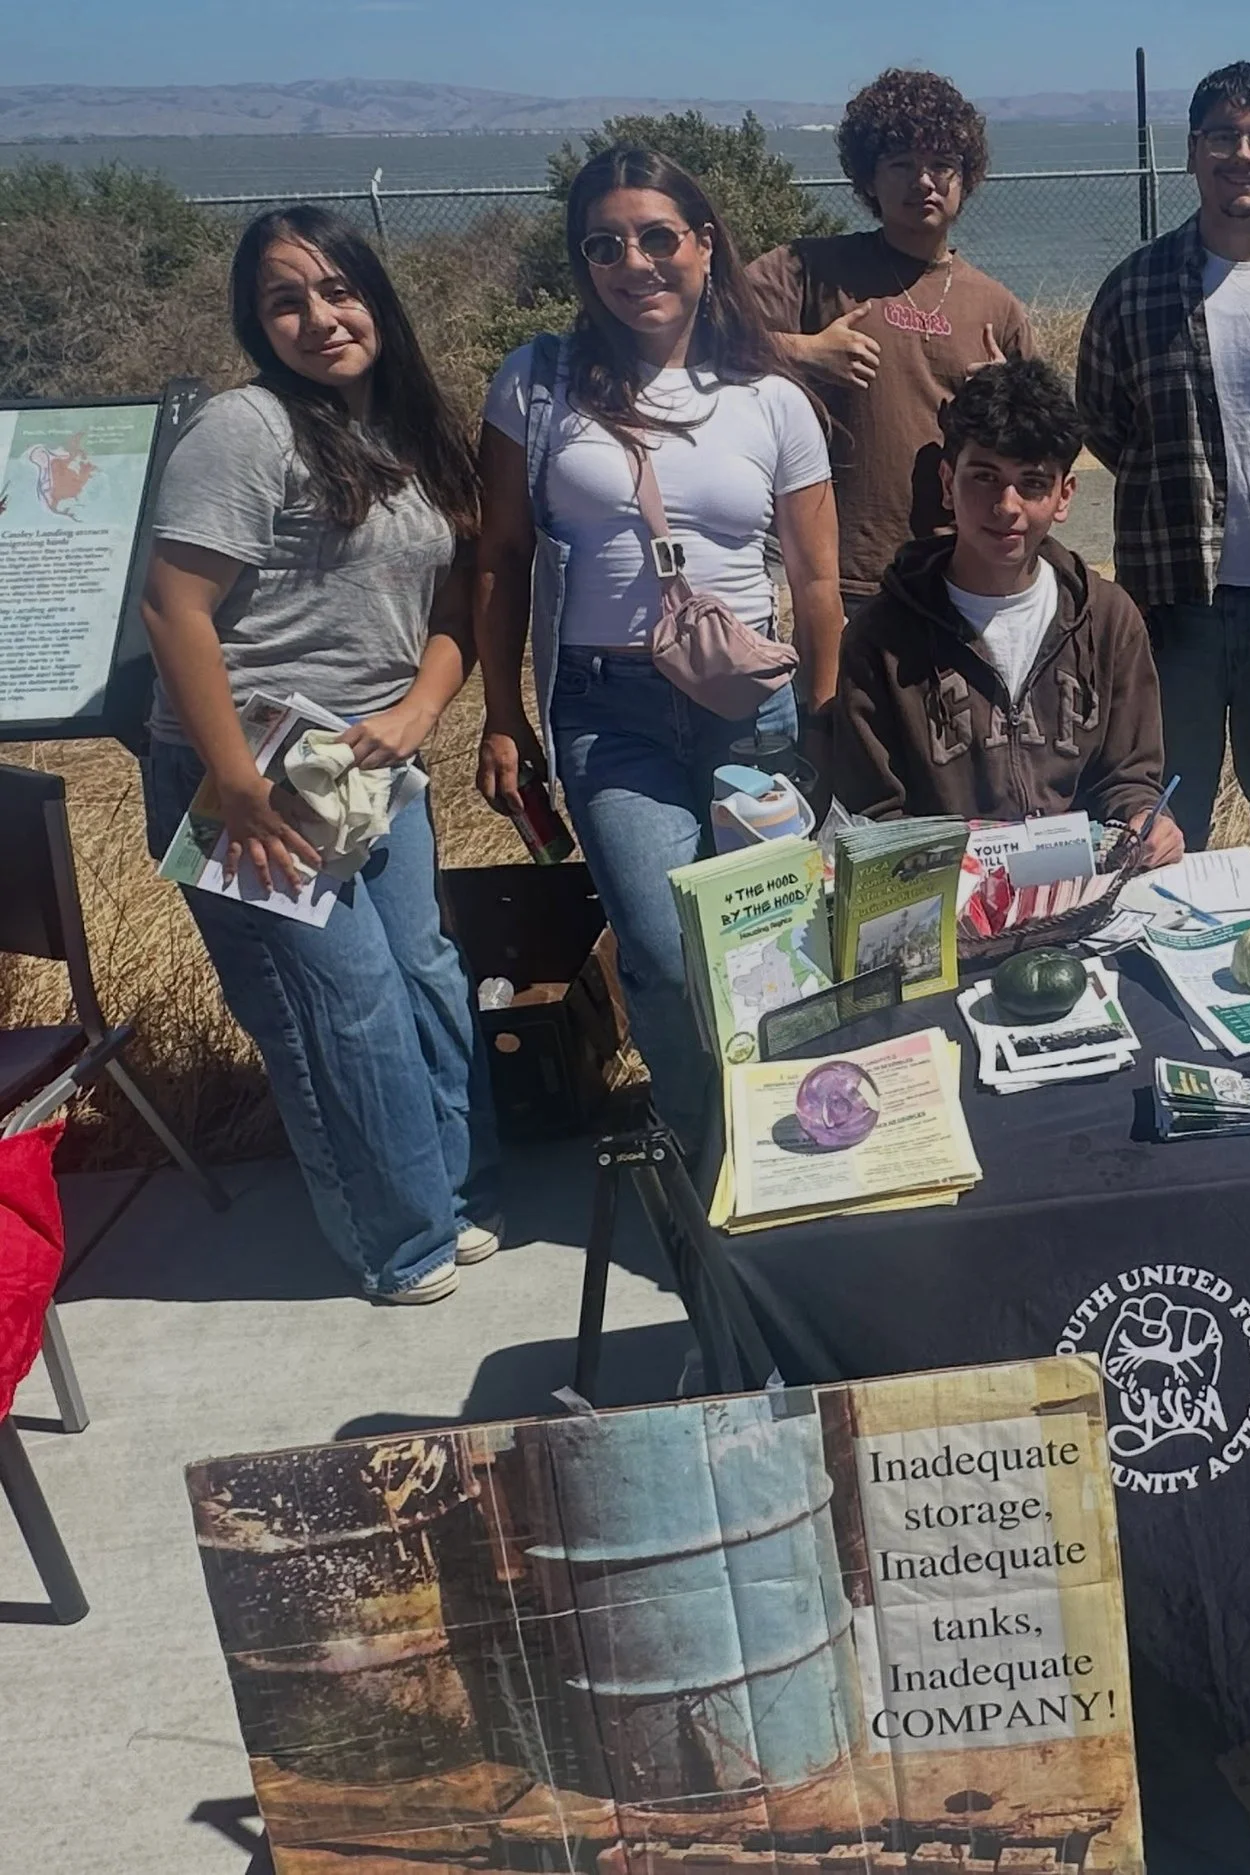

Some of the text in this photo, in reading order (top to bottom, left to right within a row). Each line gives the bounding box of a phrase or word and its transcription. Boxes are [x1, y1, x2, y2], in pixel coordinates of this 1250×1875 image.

[924, 667, 1101, 765] GAP
[974, 842, 1019, 856] YOUTH
[721, 889, 805, 926] BY THE HOOD
[725, 873, 799, 904] 4 THE HOOD
[1055, 1282, 1118, 1356] OUTH
[1117, 1264, 1234, 1303] UNITED
[869, 1440, 1081, 1484] Inadequate
[1111, 1460, 1200, 1495] UNITY
[904, 1496, 1054, 1531] storage,
[878, 1539, 1088, 1582] Inadequate
[931, 1607, 1044, 1642] tanks,
[888, 1651, 1095, 1694] Inadequate
[870, 1688, 1117, 1740] COMPANY!
